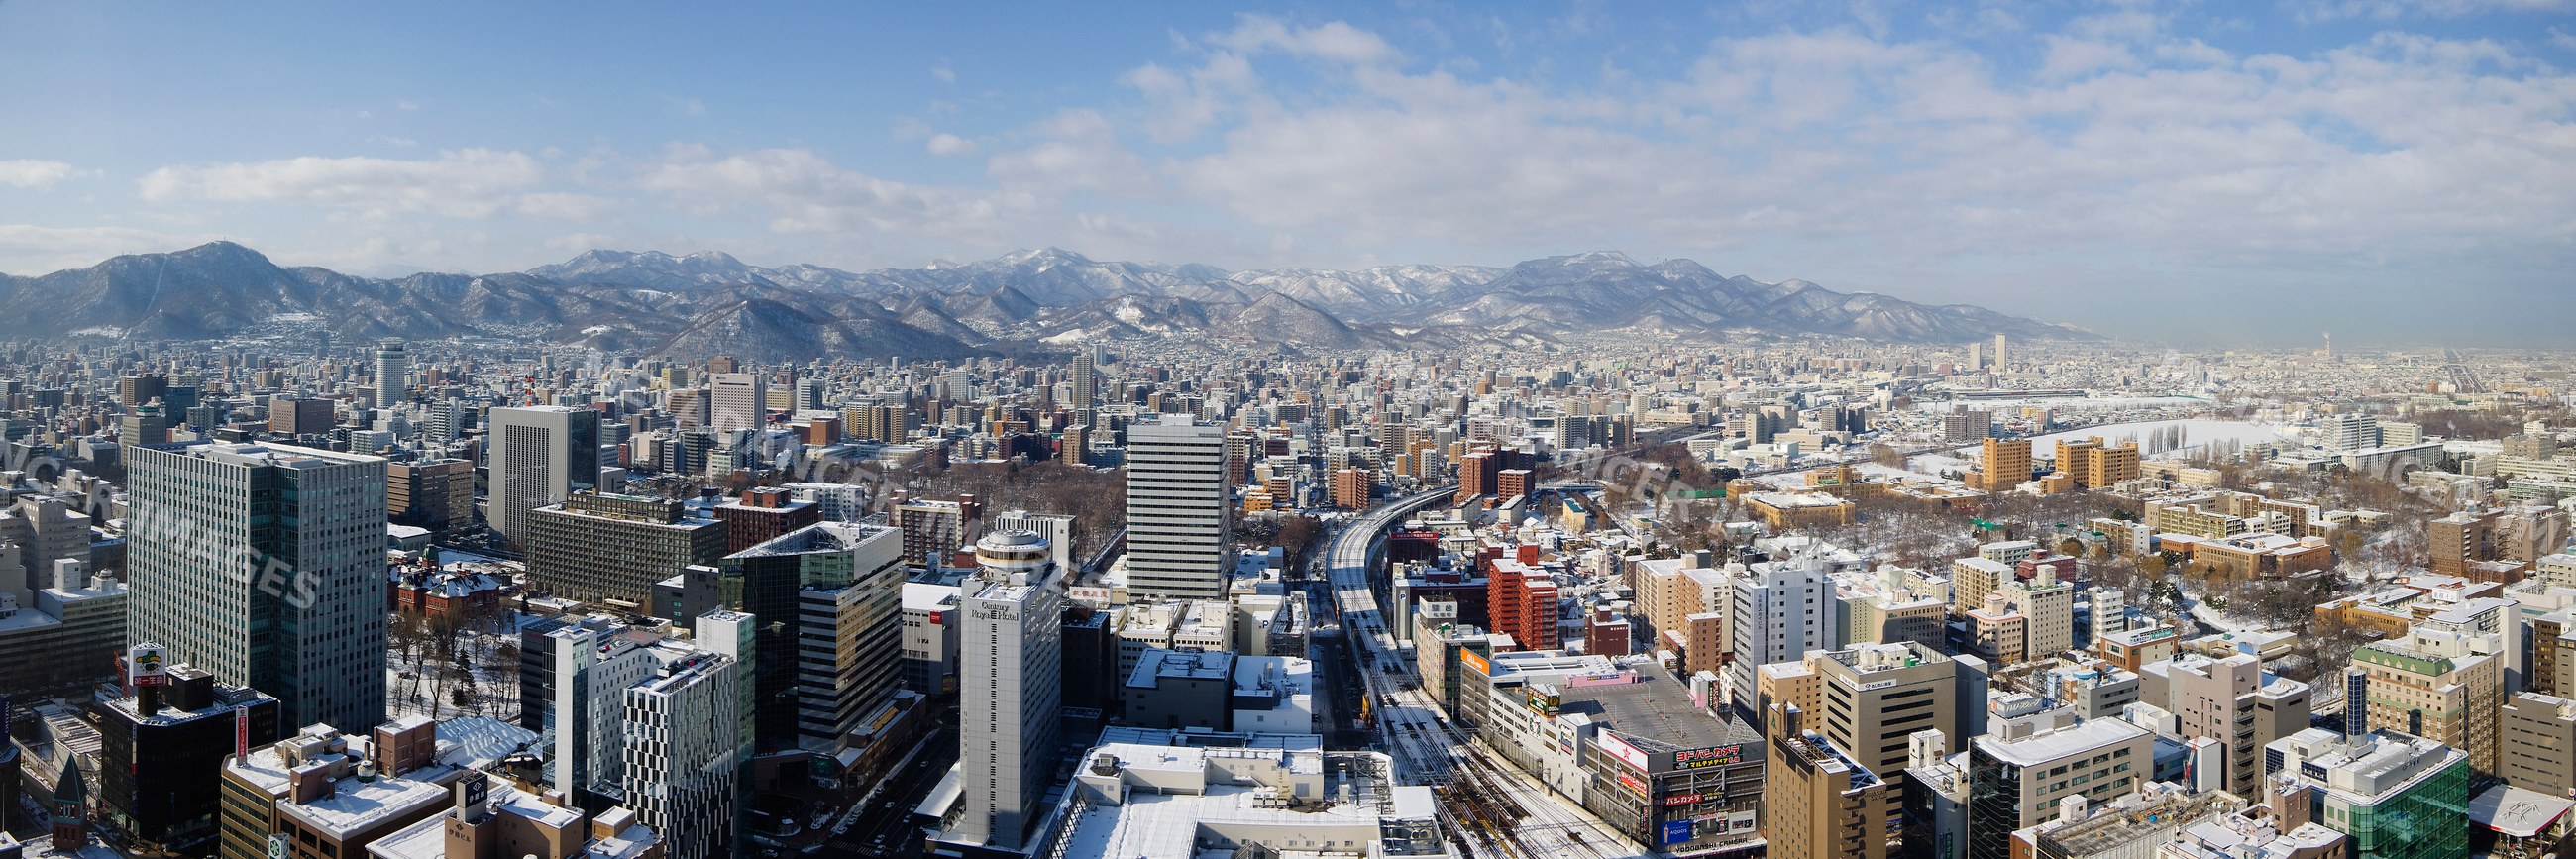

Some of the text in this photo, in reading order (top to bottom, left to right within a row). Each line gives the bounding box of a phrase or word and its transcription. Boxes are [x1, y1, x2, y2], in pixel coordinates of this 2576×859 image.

[982, 601, 1009, 612] Century
[998, 611, 1019, 621] Hotel
[1263, 620, 1269, 629] P
[134, 675, 163, 685] 第一生命
[1676, 745, 1740, 762] ヨドバシカメラ
[1719, 837, 1751, 849] CAMERA
